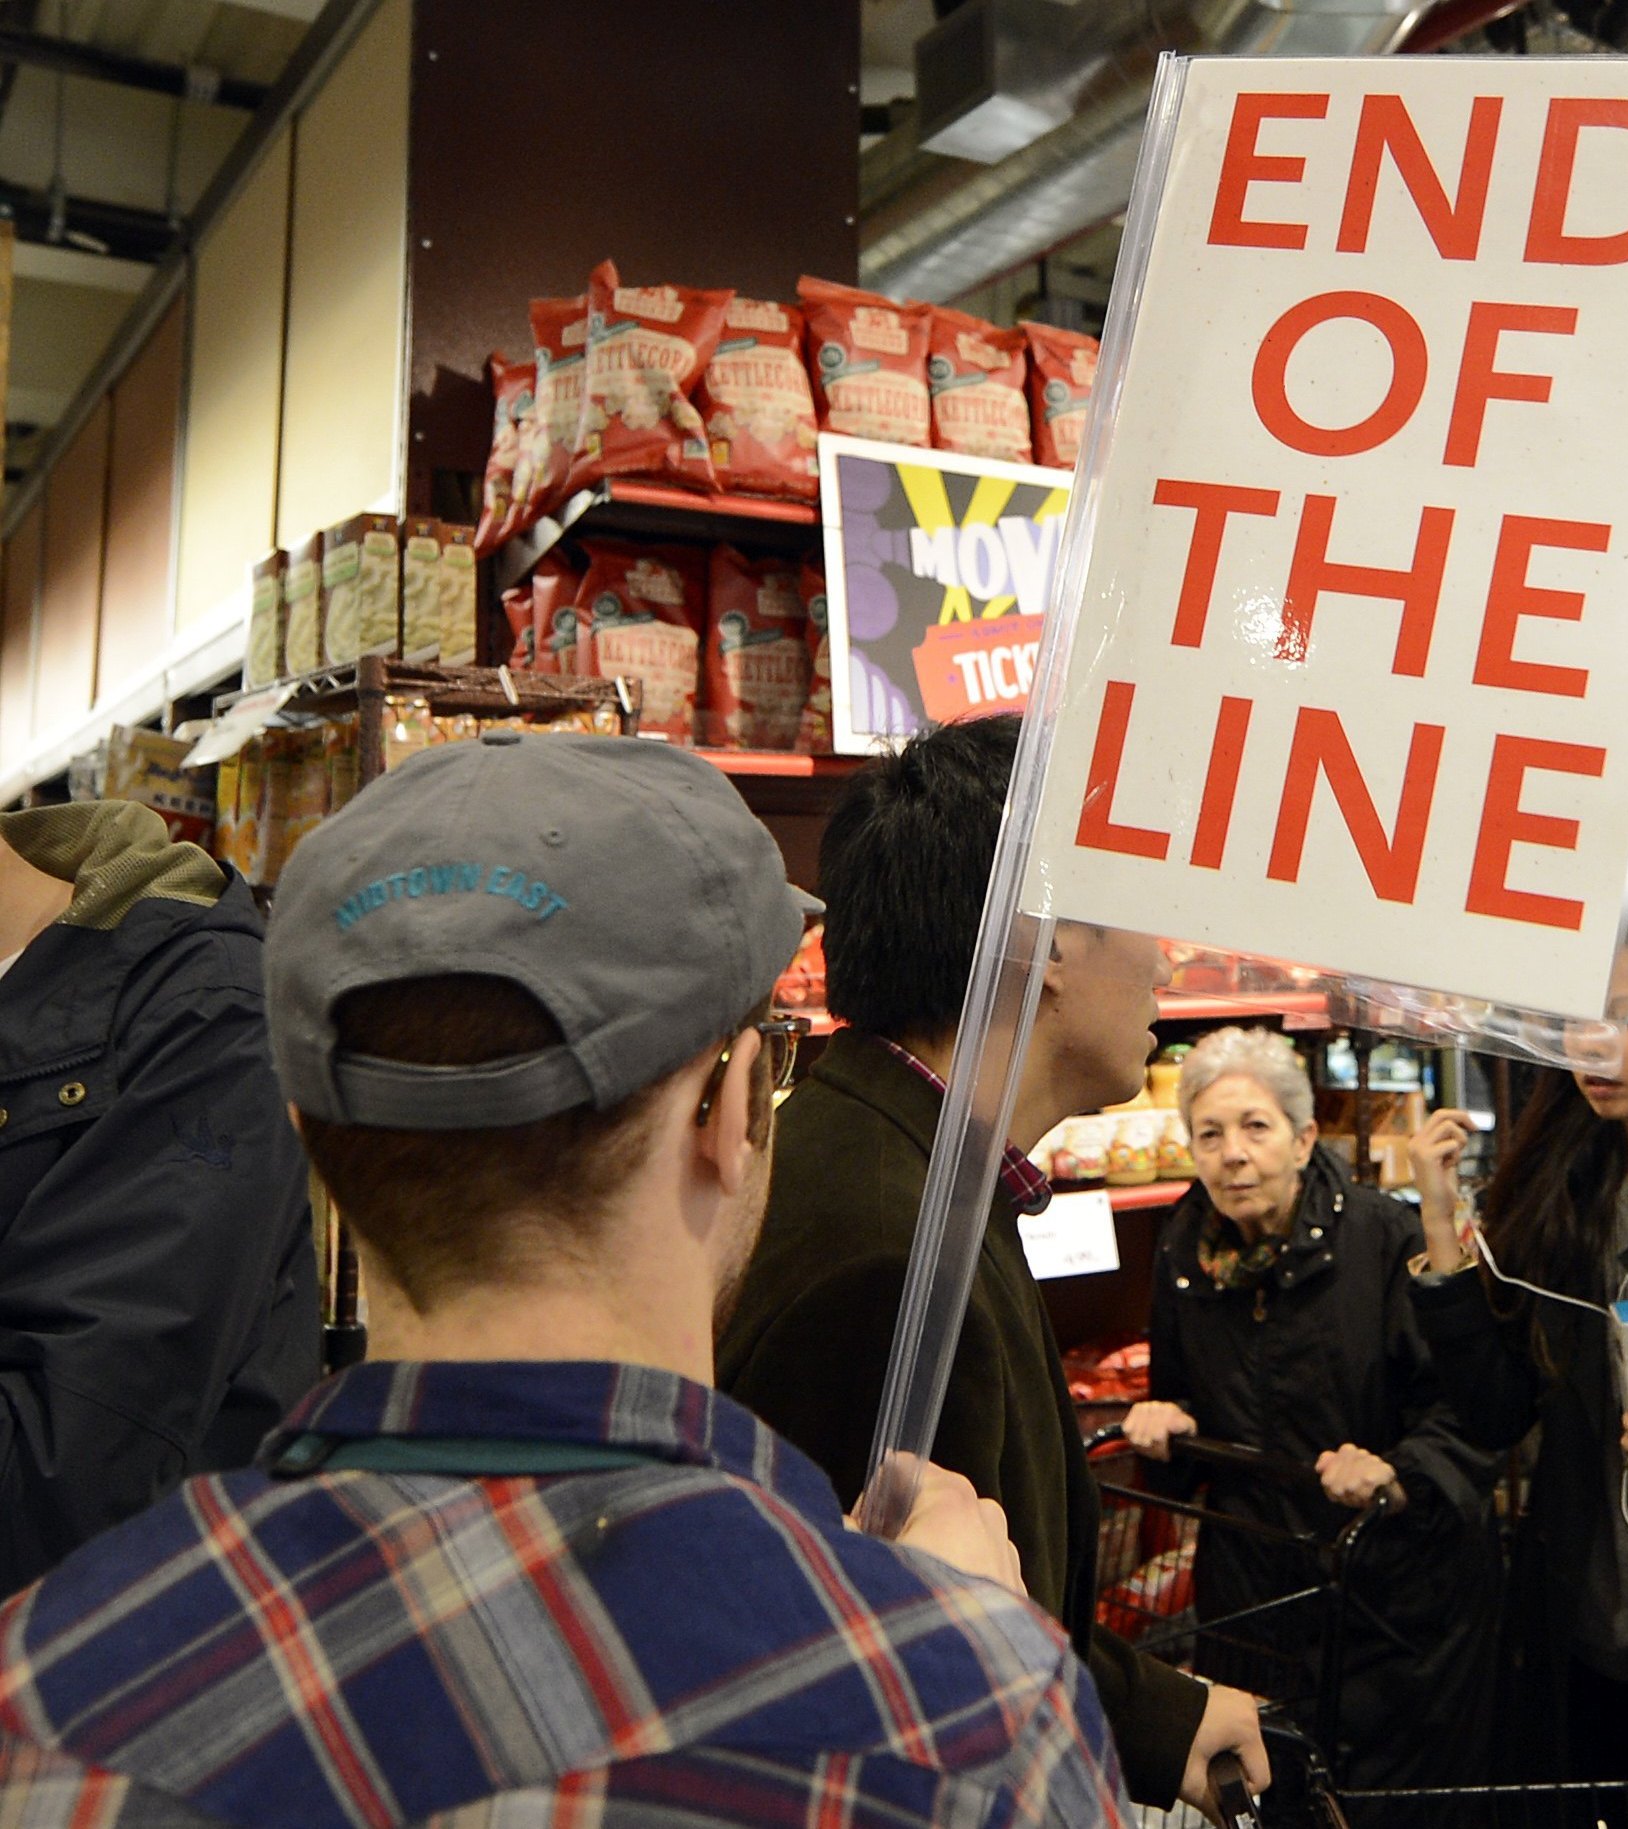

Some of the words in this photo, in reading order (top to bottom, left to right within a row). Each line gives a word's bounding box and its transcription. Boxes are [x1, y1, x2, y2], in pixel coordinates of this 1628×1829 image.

[1251, 290, 1579, 468] OF
[1153, 479, 1612, 698] THE
[485, 866, 569, 921] EAST
[1075, 680, 1607, 931] LINE
